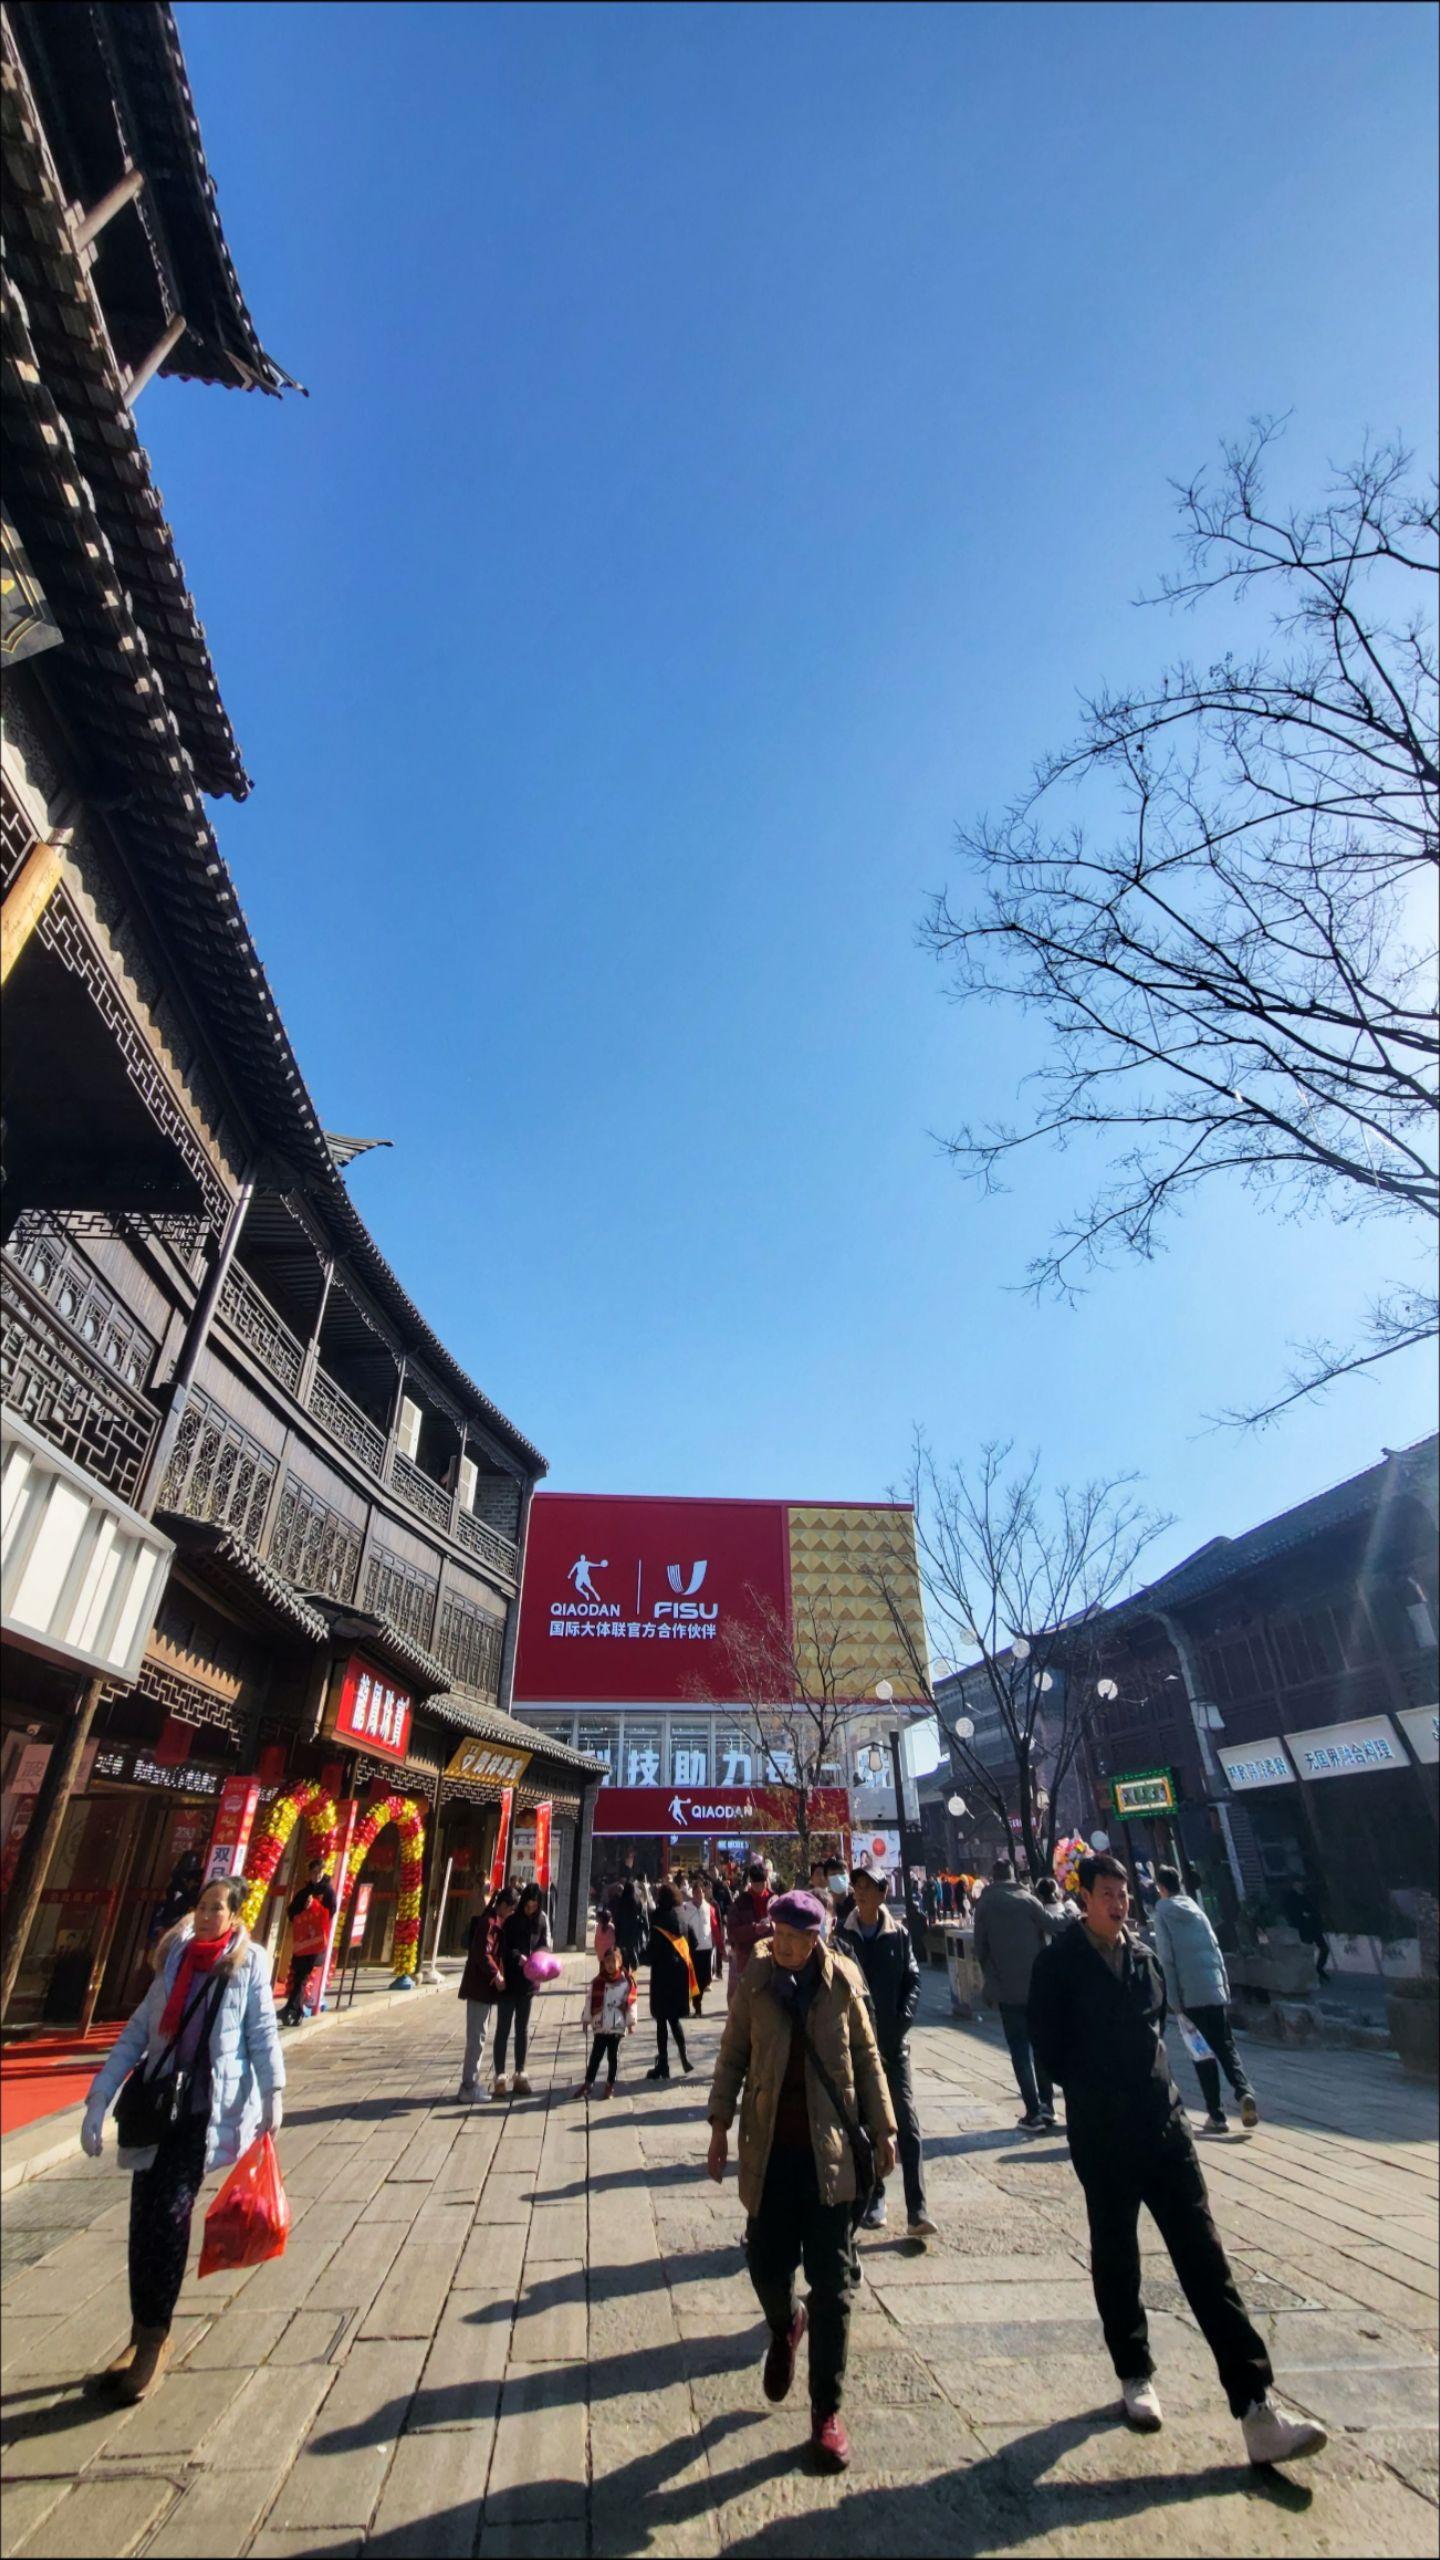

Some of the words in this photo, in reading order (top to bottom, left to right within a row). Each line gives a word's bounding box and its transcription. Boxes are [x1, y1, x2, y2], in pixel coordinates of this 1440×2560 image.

[551, 1603, 621, 1616] QIAODAN
[654, 1602, 718, 1619] FISU
[549, 1620, 717, 1639] 国际大体联官方合作伙伴
[691, 1804, 753, 1819] QIAODAN
